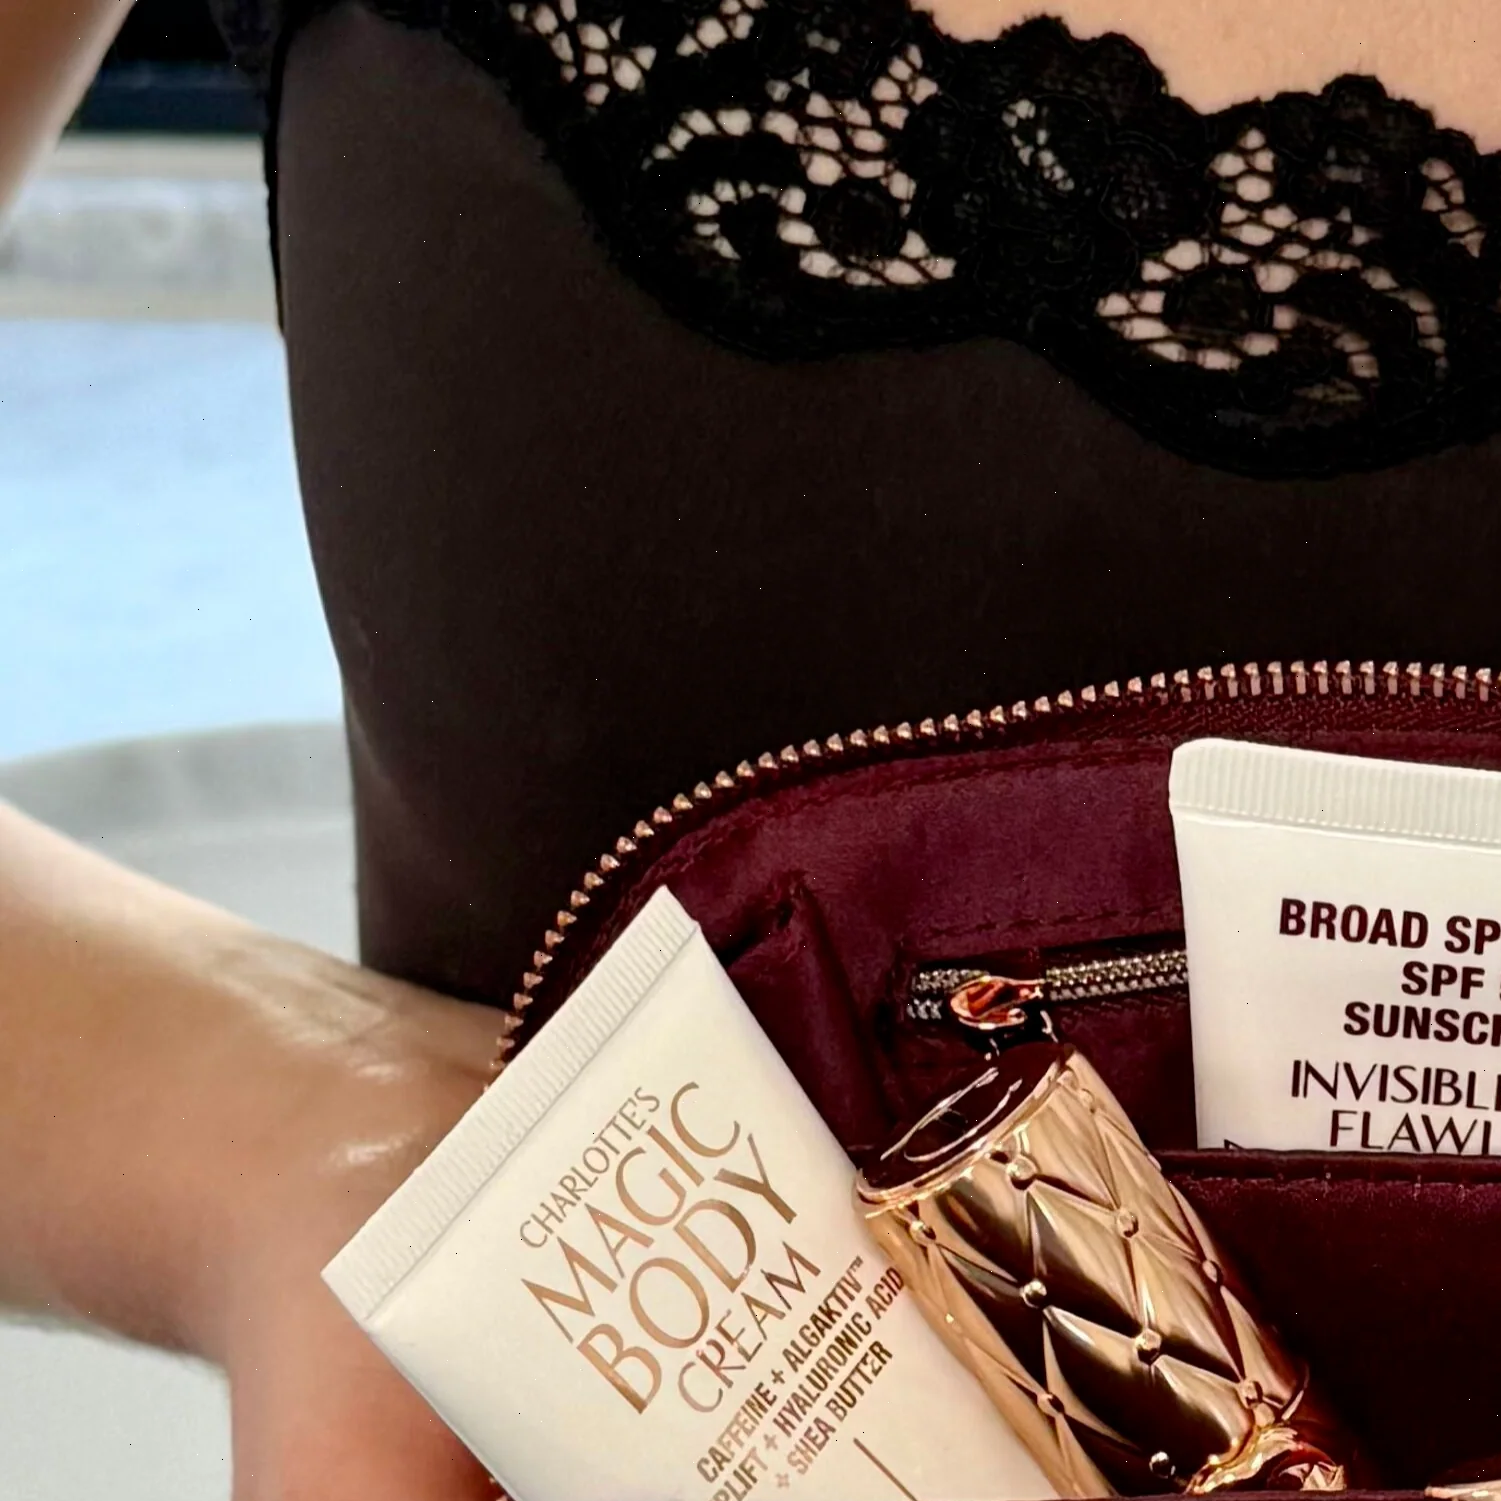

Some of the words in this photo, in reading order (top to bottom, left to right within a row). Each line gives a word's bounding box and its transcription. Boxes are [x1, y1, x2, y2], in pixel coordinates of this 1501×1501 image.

[1279, 898, 1428, 948] BROAD
[1401, 962, 1485, 1000] SPF
[519, 1086, 661, 1248] CHARLOTTE'S
[521, 1081, 741, 1344] MAGIC
[576, 1133, 797, 1415] BODY
[677, 1241, 821, 1413] CREAM
[772, 1312, 873, 1438] HYALURONIC
[864, 1266, 905, 1320] ACID
[696, 1382, 778, 1484] CAFFEINE
[786, 1416, 837, 1475] SHEA
[824, 1340, 894, 1423] BUTTER
